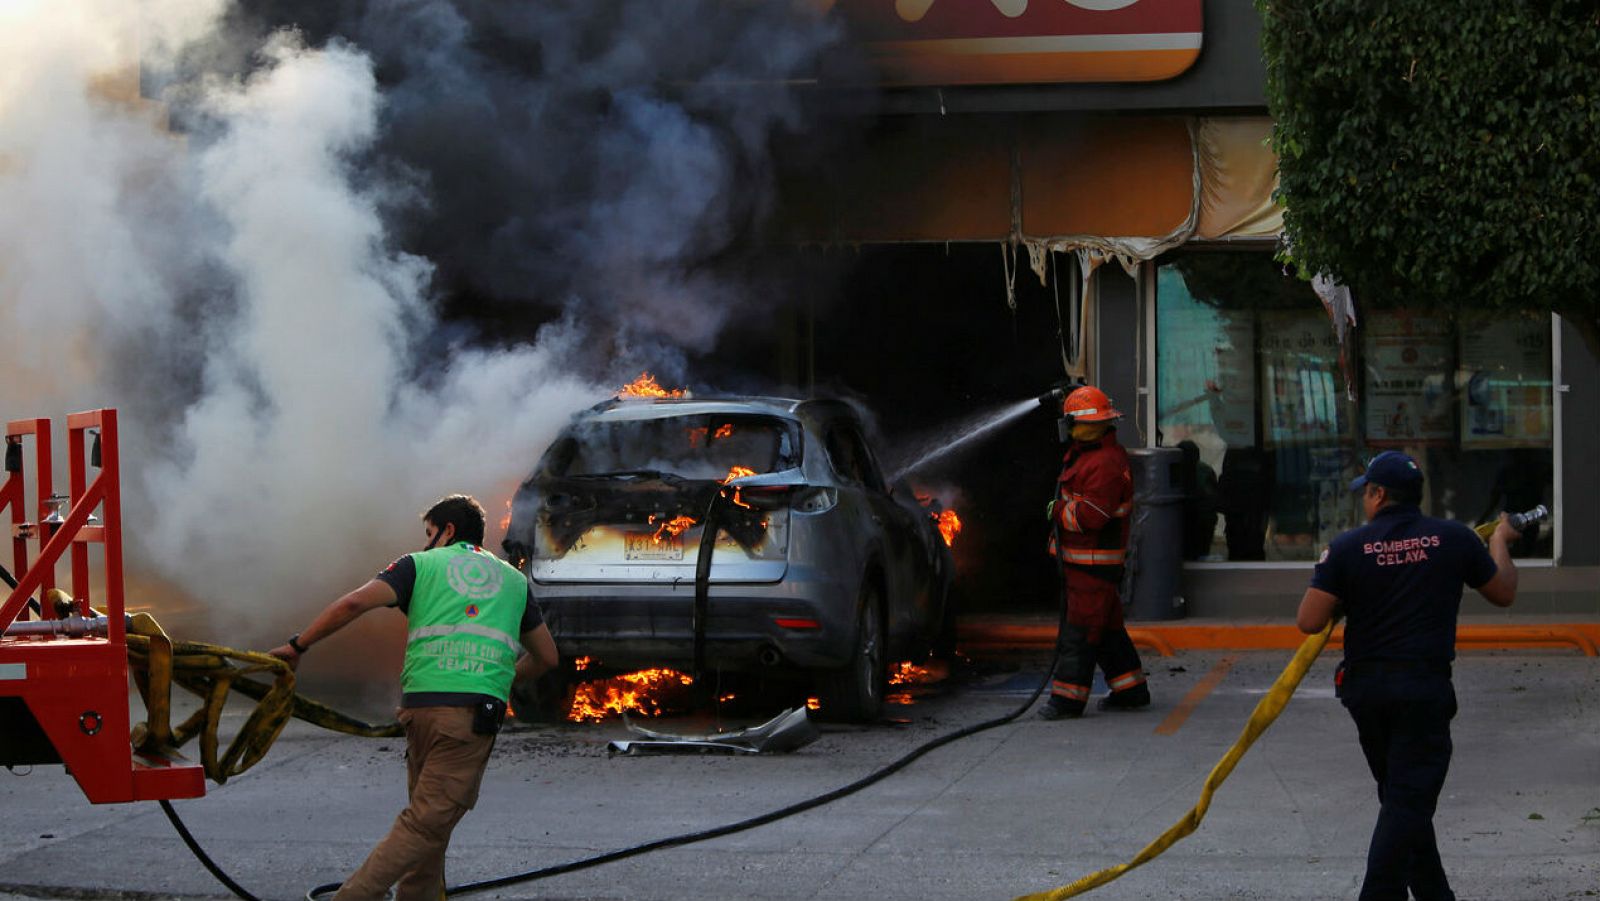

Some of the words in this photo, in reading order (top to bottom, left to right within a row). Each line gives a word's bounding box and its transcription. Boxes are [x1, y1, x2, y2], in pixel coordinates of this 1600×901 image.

[1364, 536, 1440, 554] BOMBEROS
[1376, 549, 1428, 566] CELAYA
[437, 658, 484, 673] CELAYA
